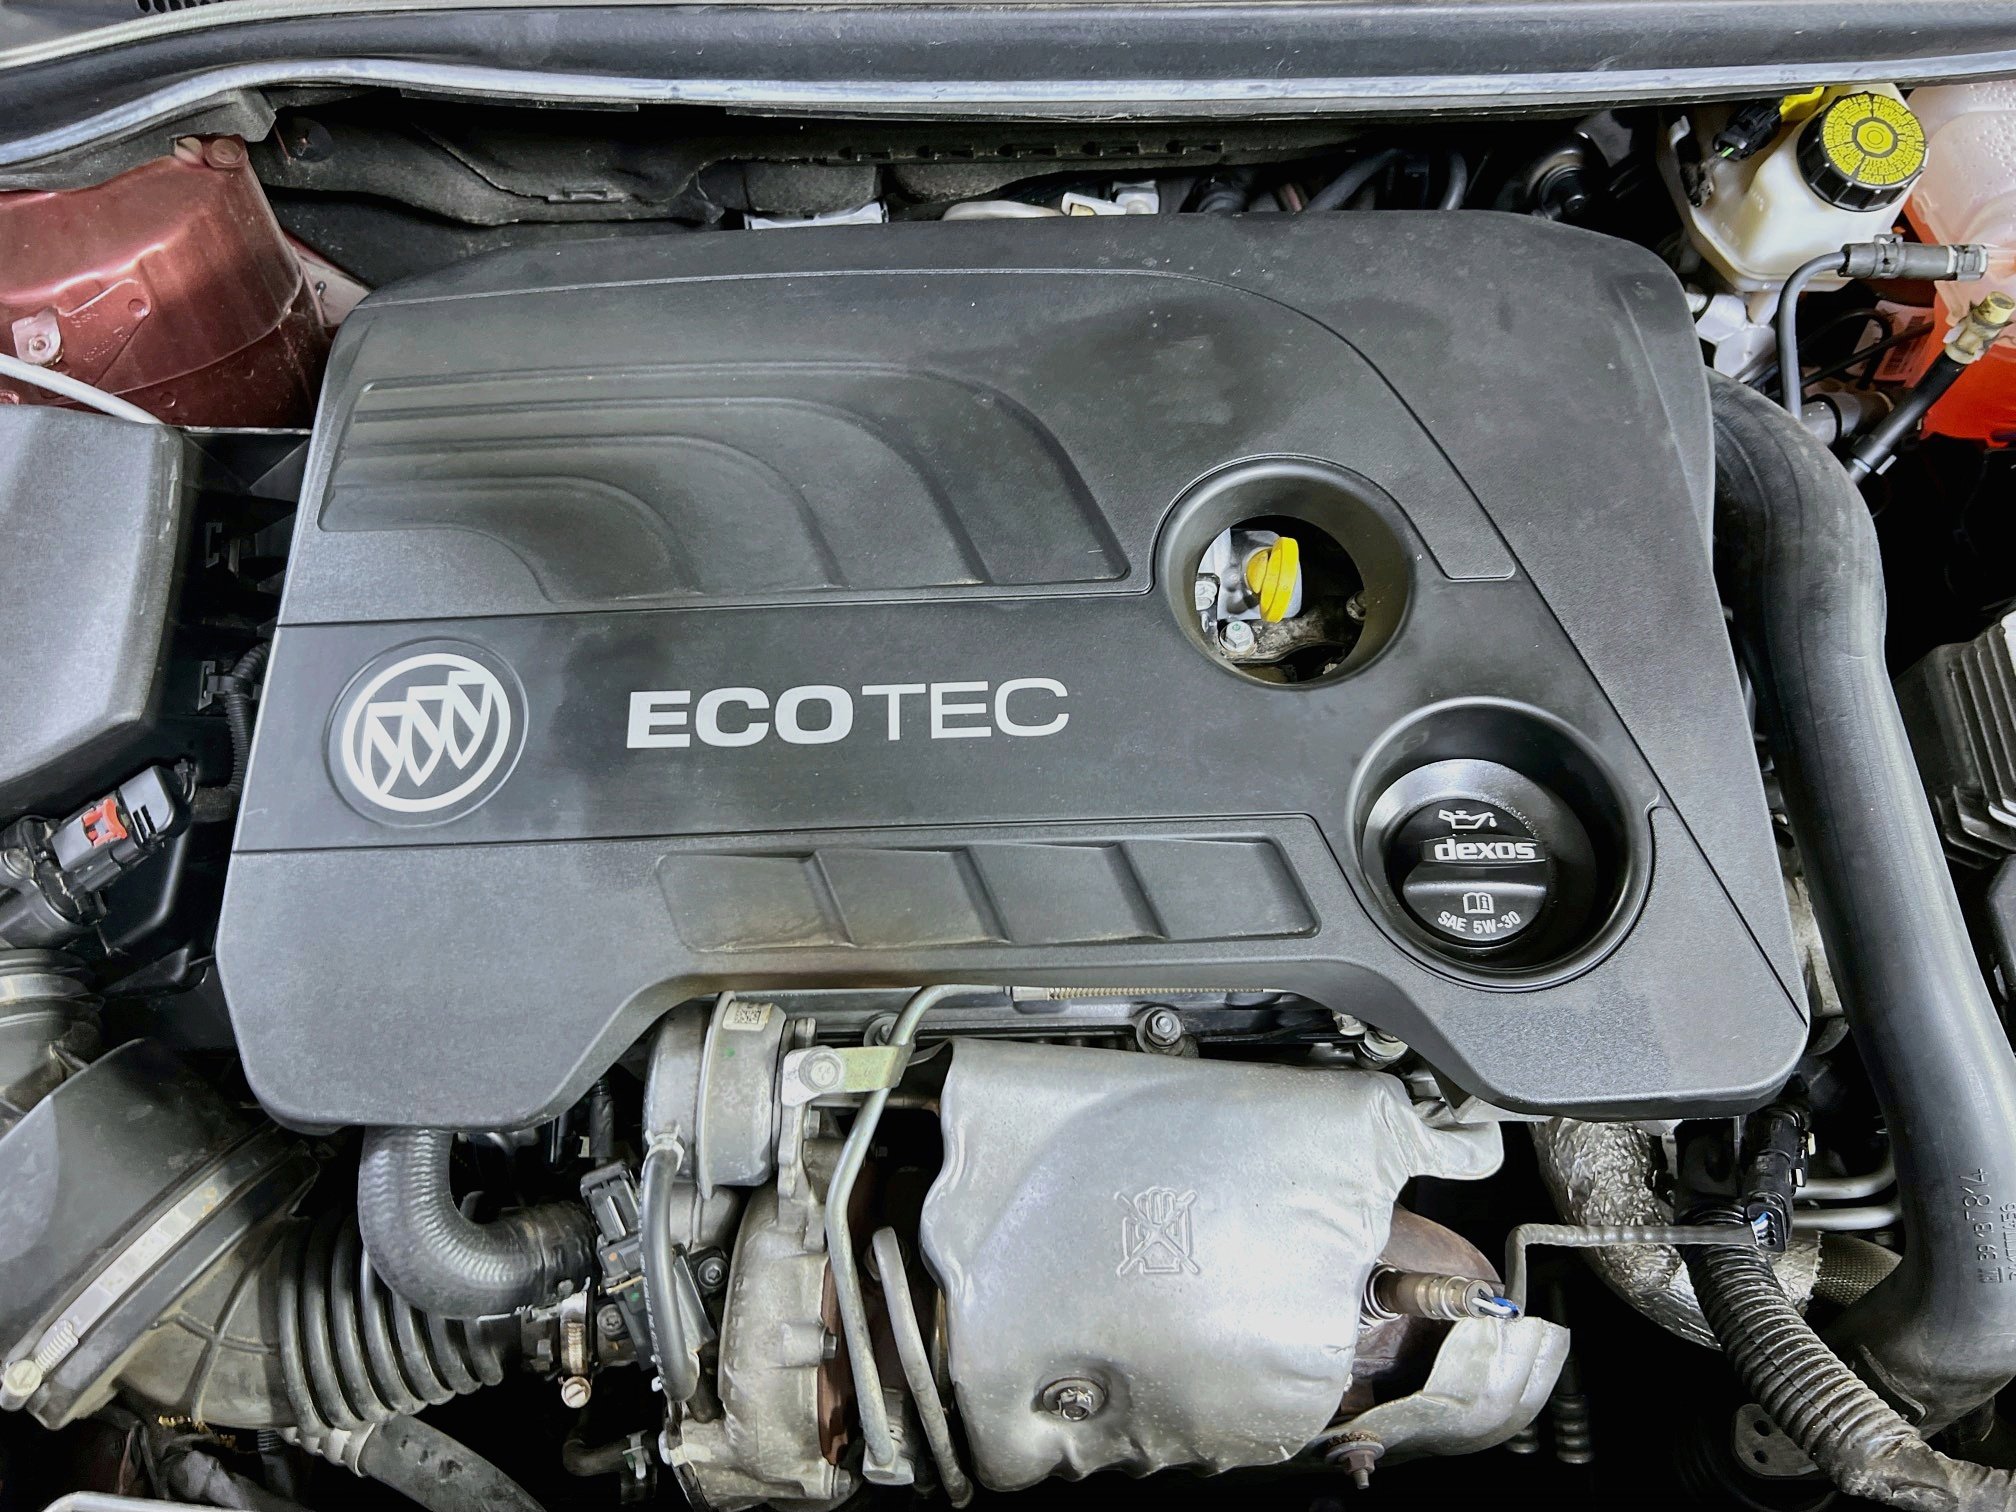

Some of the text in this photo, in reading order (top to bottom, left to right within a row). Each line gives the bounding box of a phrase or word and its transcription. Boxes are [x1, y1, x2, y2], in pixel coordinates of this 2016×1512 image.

[626, 677, 1069, 750] ECOTEC
[1434, 838, 1536, 861] dexos
[1437, 910, 1521, 934] SAE 5W-30
